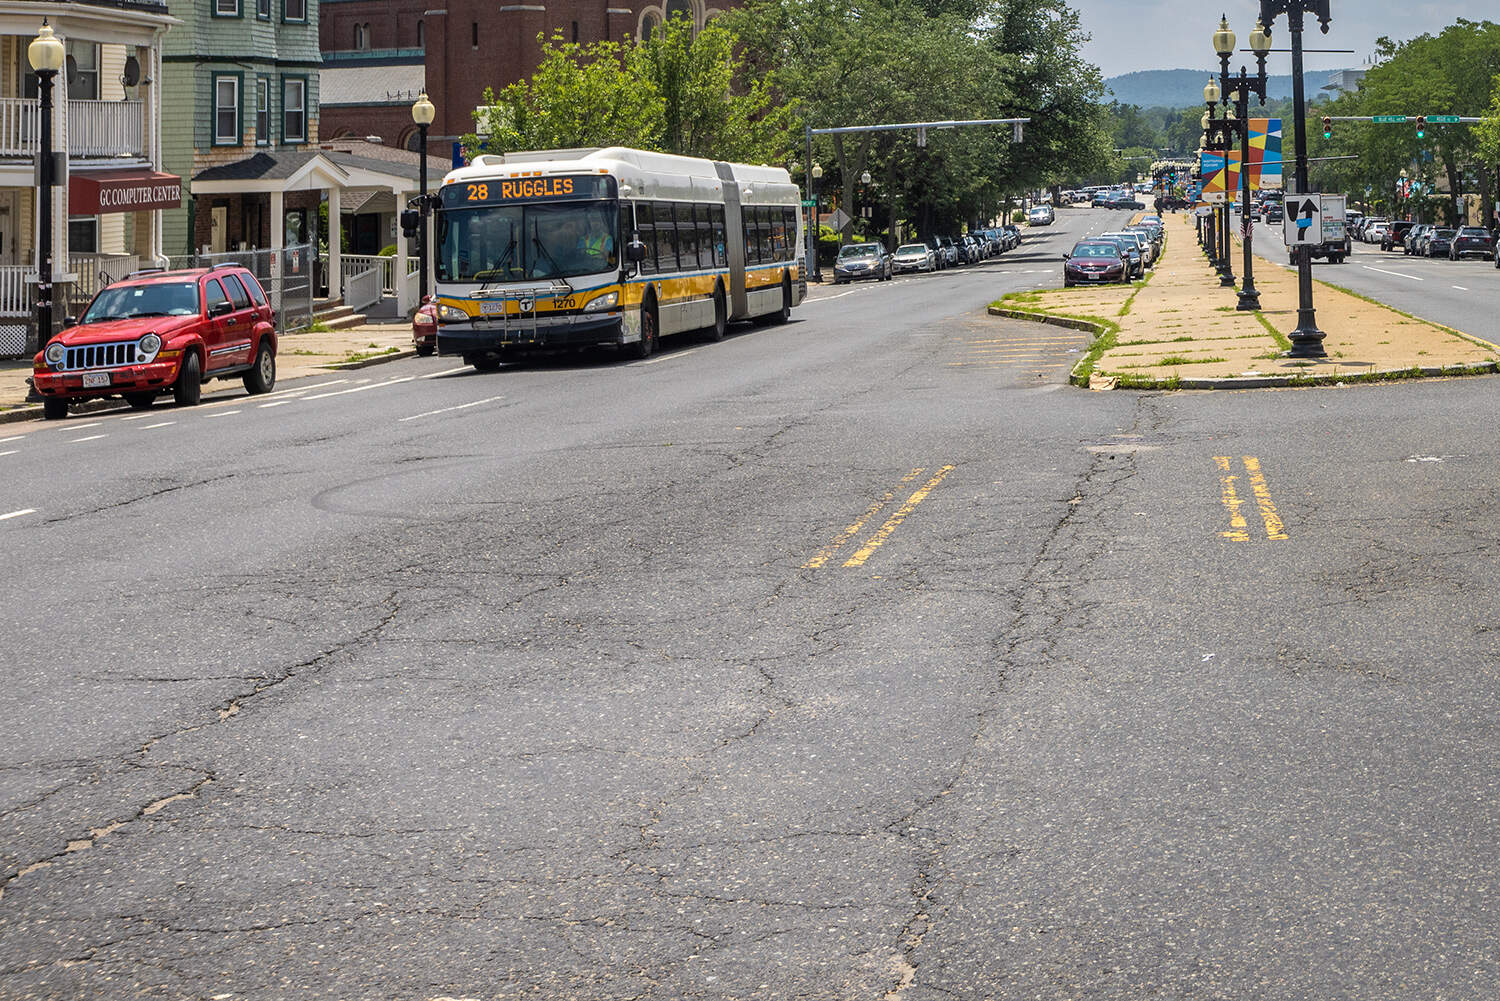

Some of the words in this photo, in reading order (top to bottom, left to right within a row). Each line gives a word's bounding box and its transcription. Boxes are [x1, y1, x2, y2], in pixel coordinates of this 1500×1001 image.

[100, 189, 112, 206] GC
[112, 186, 153, 205] COMPUTER
[153, 185, 181, 202] CENTER
[467, 184, 488, 201] 28
[502, 178, 574, 199] RUGGLES
[552, 299, 576, 308] 1270
